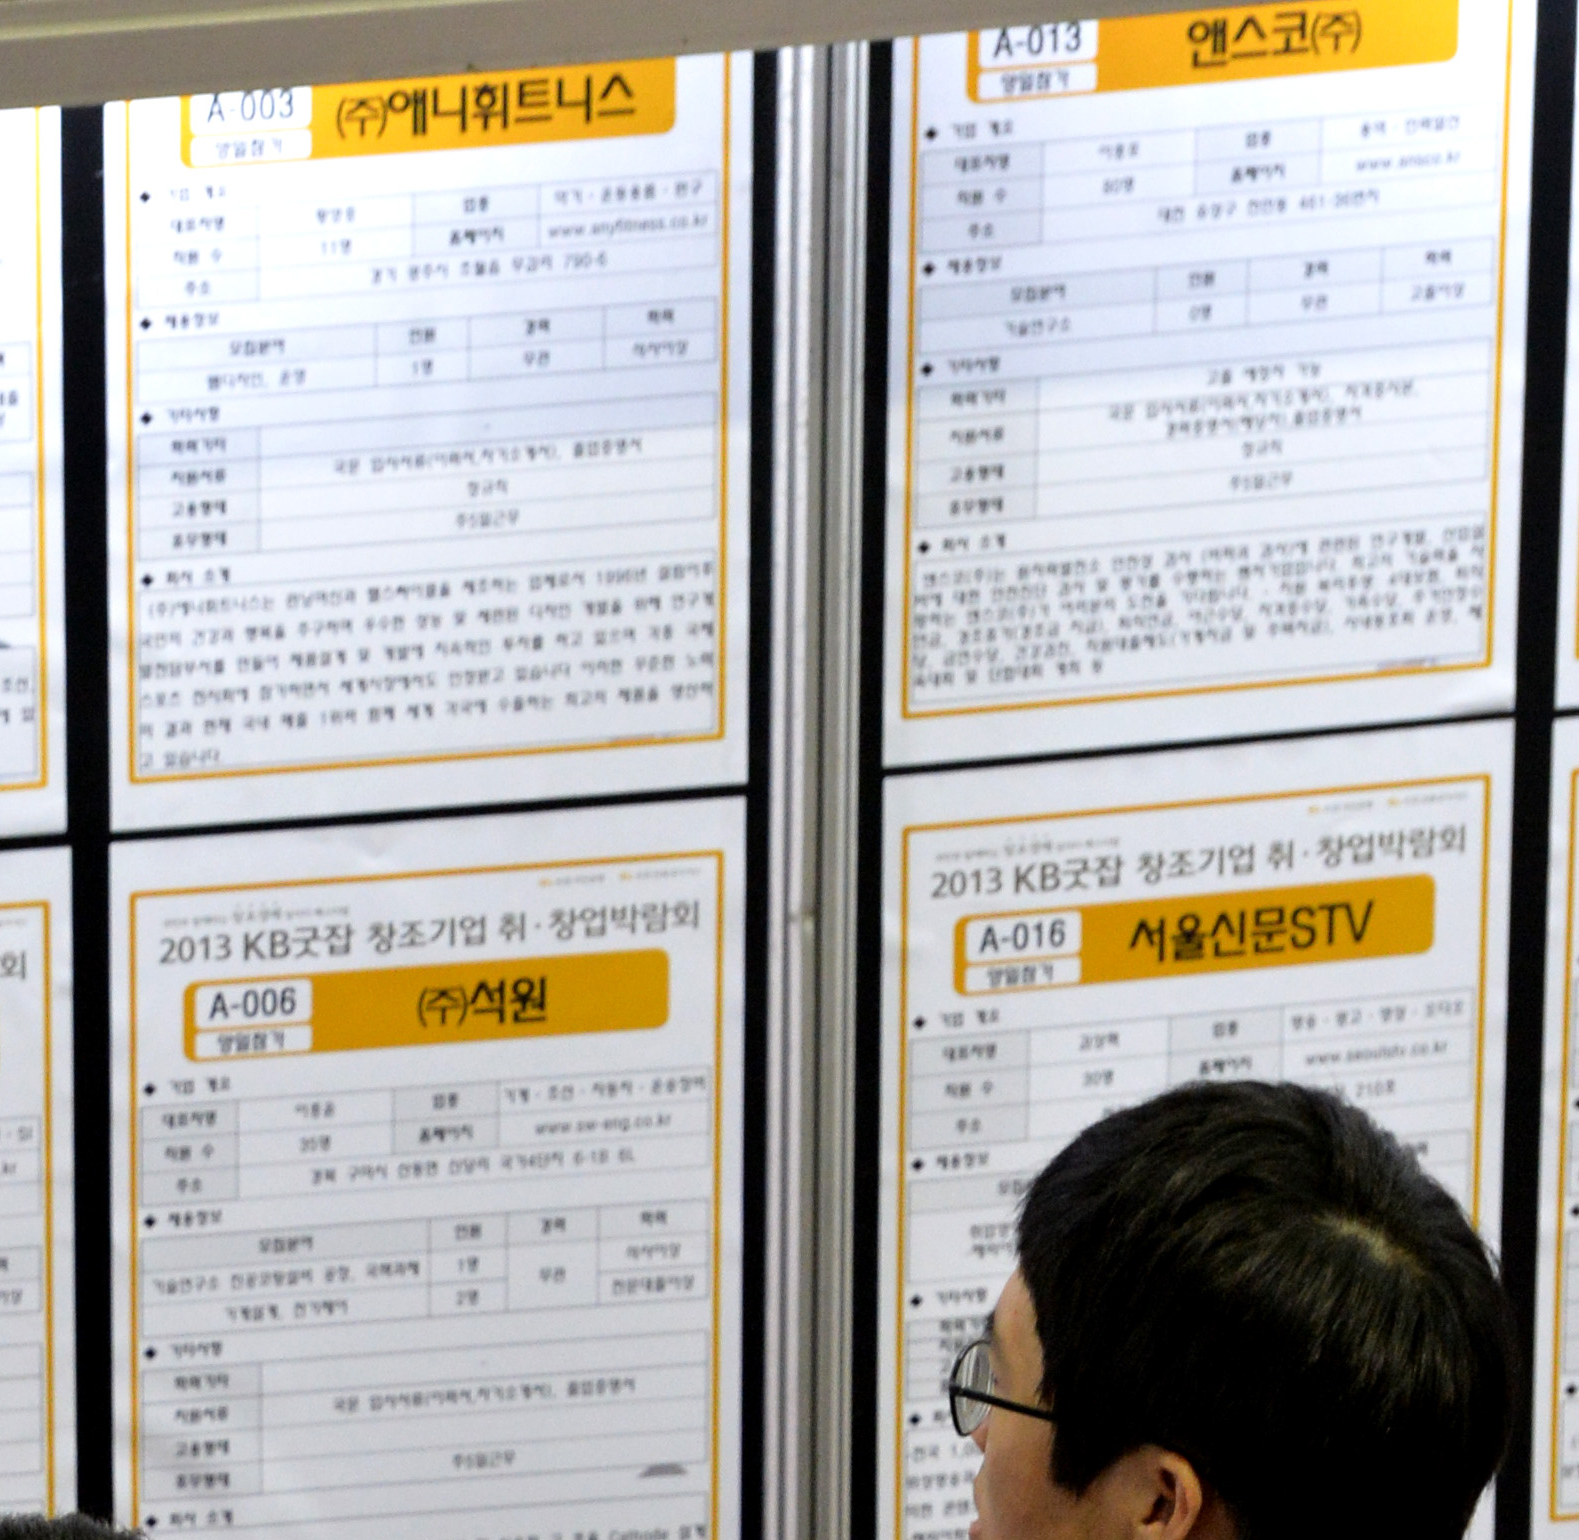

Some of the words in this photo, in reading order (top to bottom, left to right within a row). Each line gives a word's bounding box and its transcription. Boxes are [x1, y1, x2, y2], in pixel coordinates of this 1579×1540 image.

[993, 22, 1082, 59] A-013
[1186, 11, 1363, 68] 앤스코(주)
[207, 88, 295, 123] A-003
[931, 869, 1004, 898] 2013
[1013, 857, 1124, 895] KB굿잡
[1136, 844, 1256, 885] 창조기업
[159, 934, 233, 965] 2013
[242, 927, 354, 962] KB굿잡
[368, 915, 488, 952] 창조기업
[979, 919, 1067, 954] A-016
[1129, 899, 1375, 962] 서울신문STV
[987, 964, 1055, 987] 양일참가
[209, 988, 296, 1021] A-006
[417, 975, 549, 1028] (주)석원
[218, 1032, 286, 1054] 양일참가
